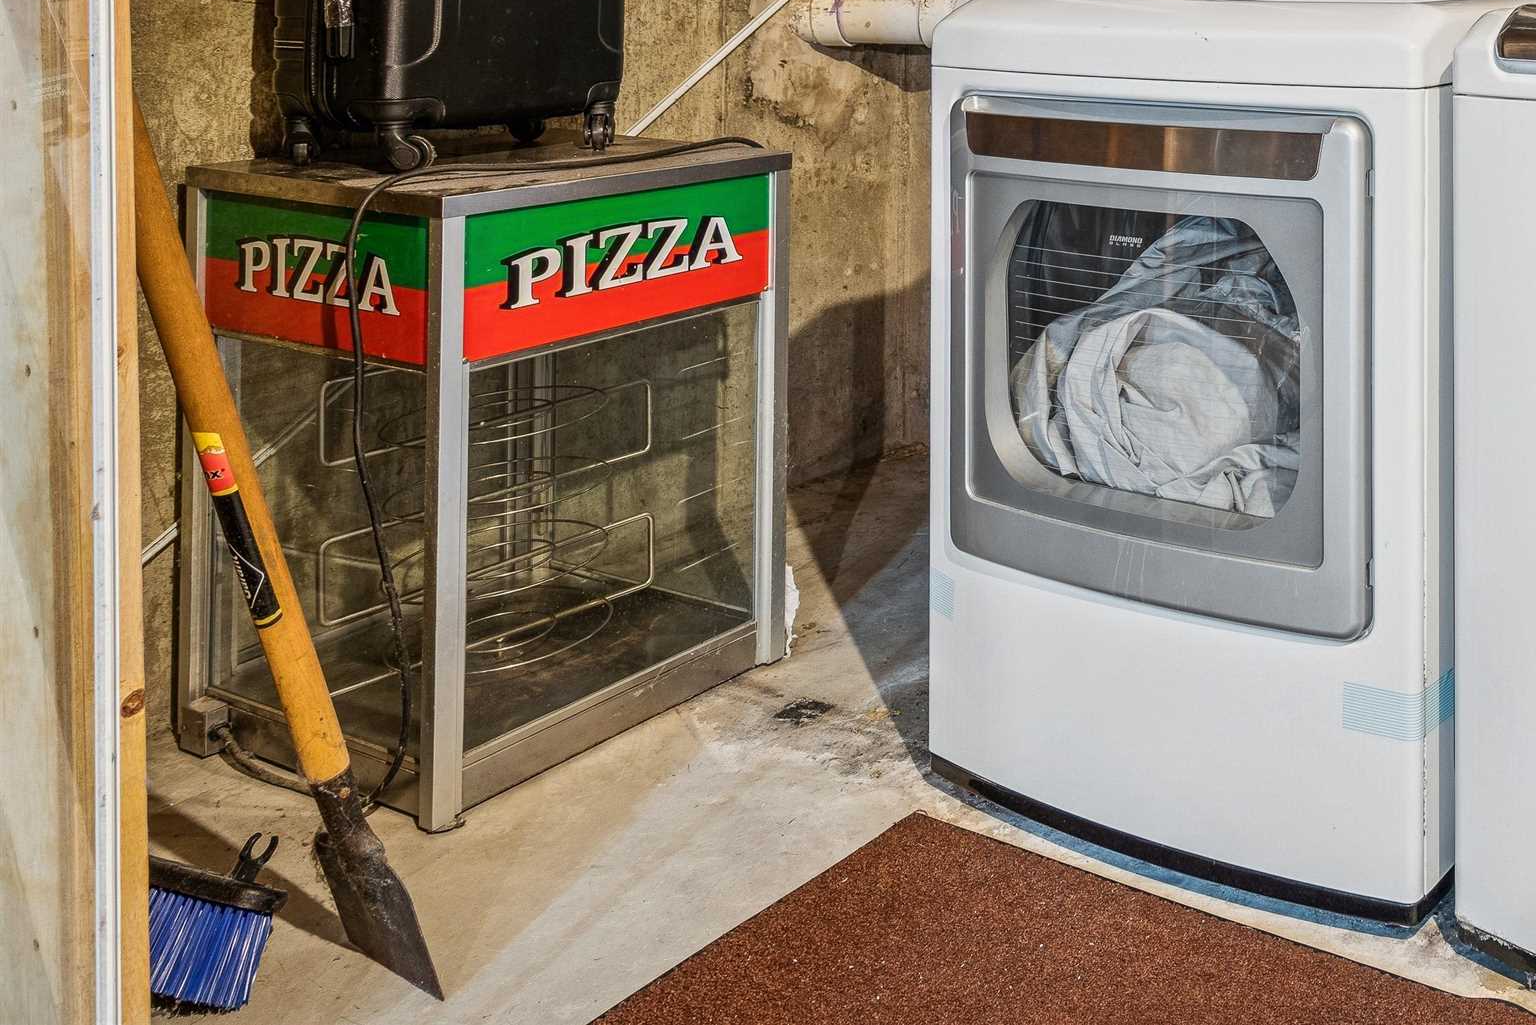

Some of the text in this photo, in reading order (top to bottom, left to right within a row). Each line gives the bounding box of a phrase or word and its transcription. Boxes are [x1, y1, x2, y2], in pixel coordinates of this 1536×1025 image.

[238, 237, 400, 316] PIZZA
[507, 216, 743, 311] PIZZA
[1110, 235, 1142, 243] DIAMOND
